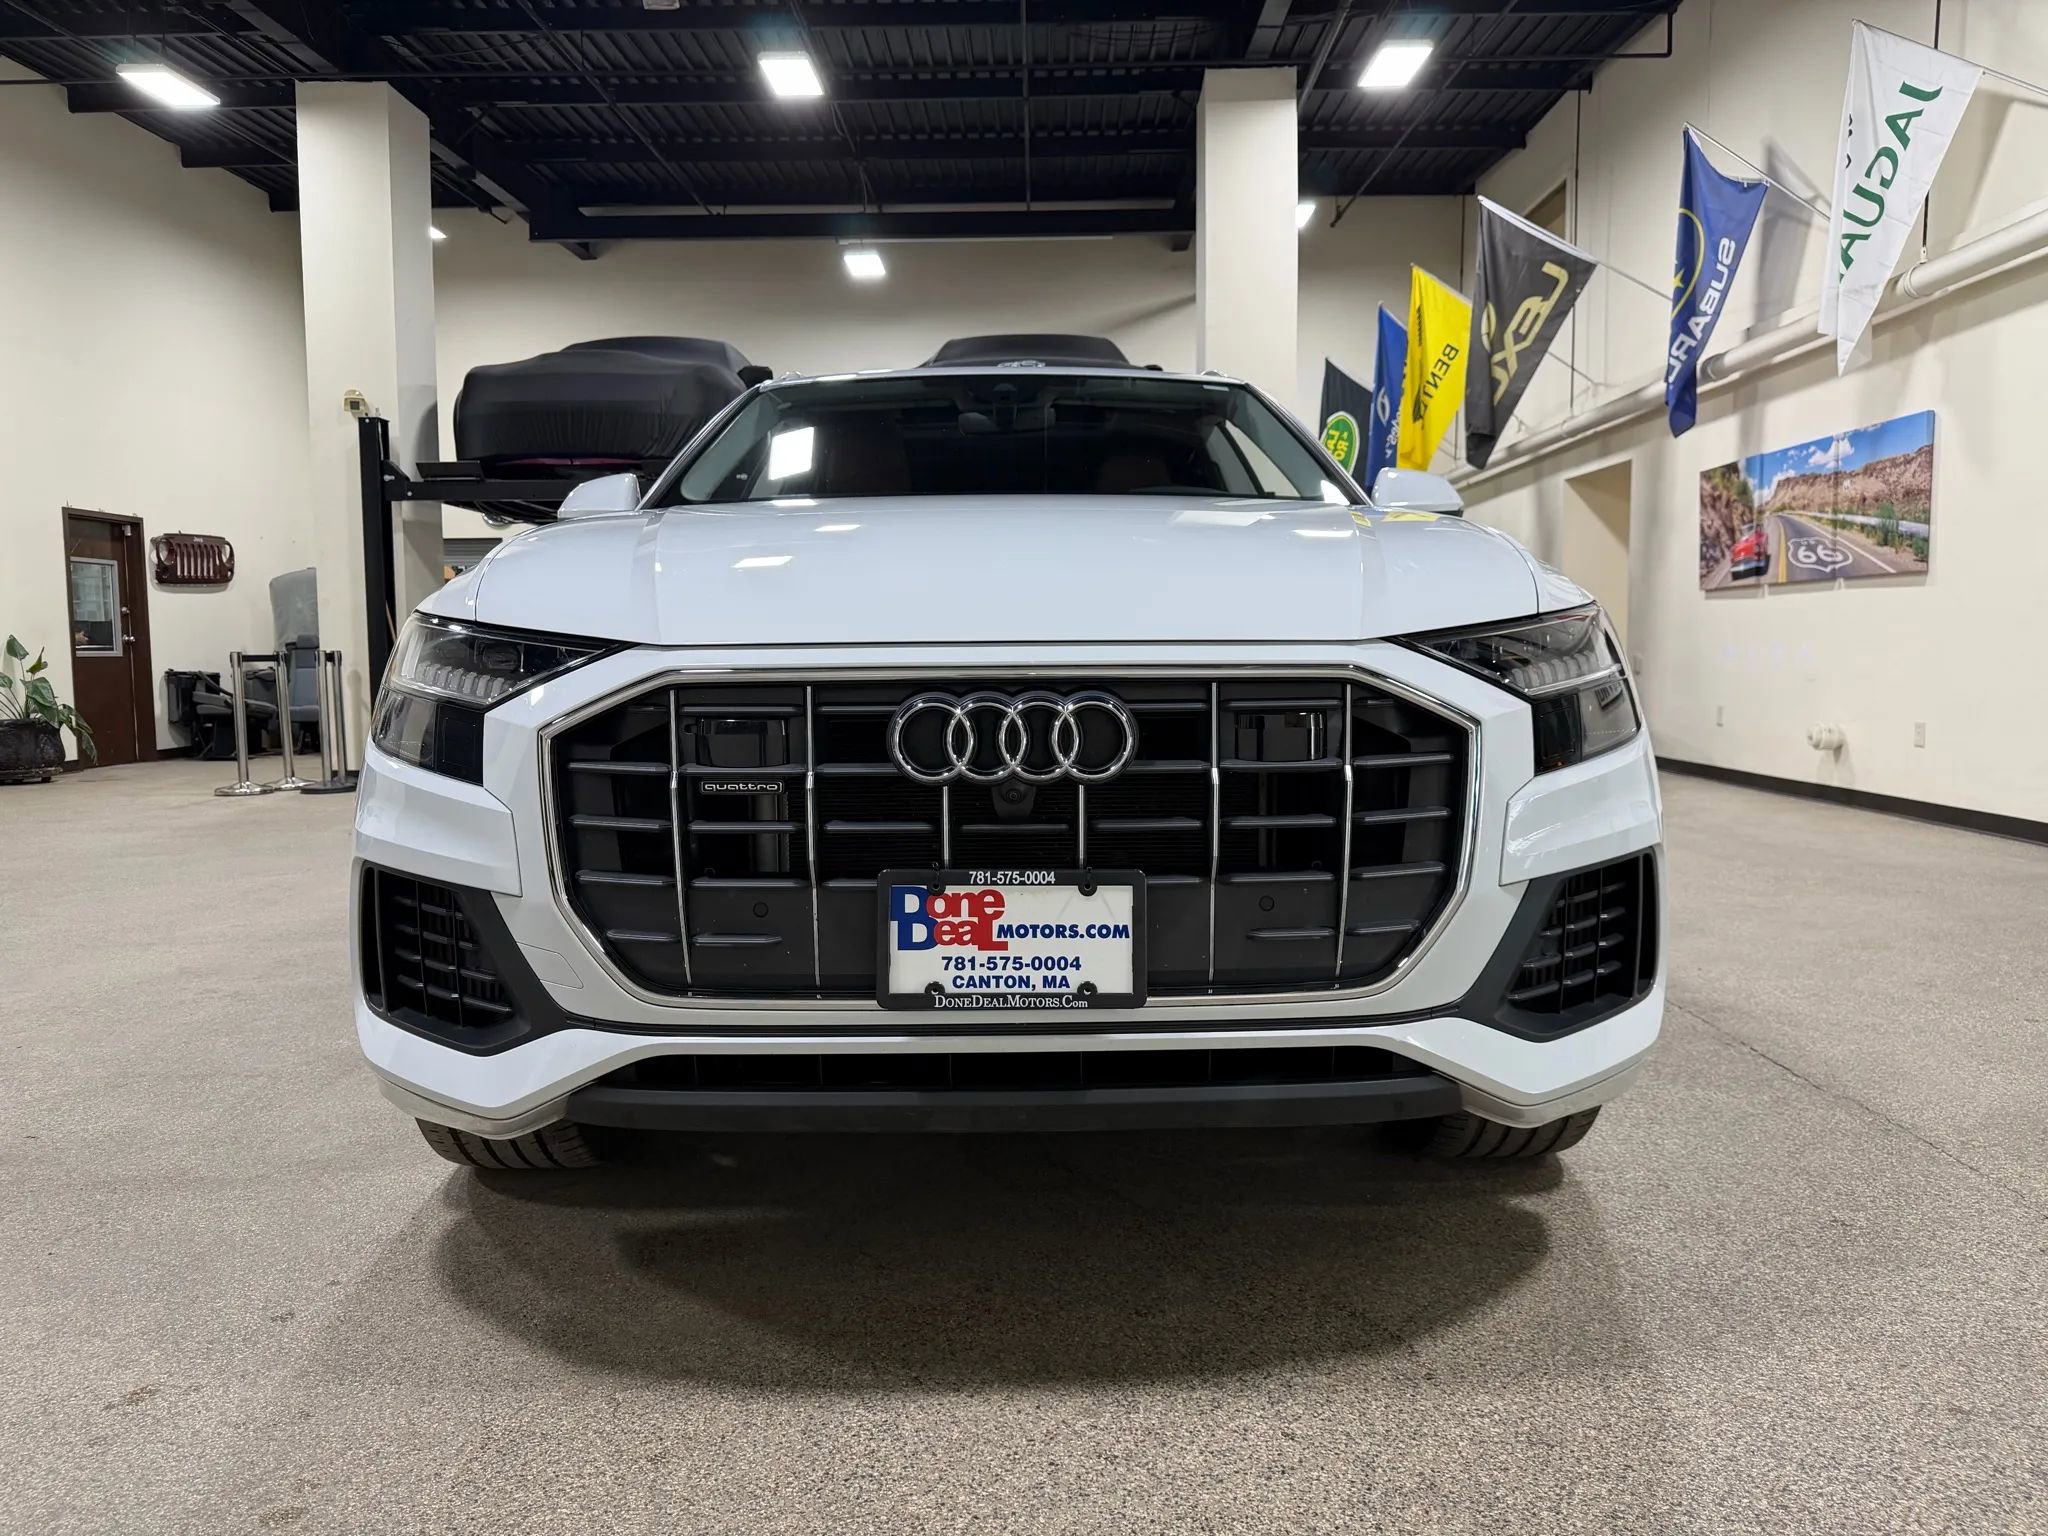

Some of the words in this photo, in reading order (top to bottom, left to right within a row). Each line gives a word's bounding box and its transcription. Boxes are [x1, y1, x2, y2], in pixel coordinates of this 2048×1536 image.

[1797, 545, 1843, 563] 66
[704, 783, 778, 792] quattro
[969, 871, 1056, 885] 781-575-0004
[890, 886, 1006, 922] Done
[996, 924, 1130, 939] MOTORS.COM
[941, 956, 1082, 971] 781-575-0004
[952, 974, 1036, 991] CANTON,
[1042, 975, 1071, 989] MA
